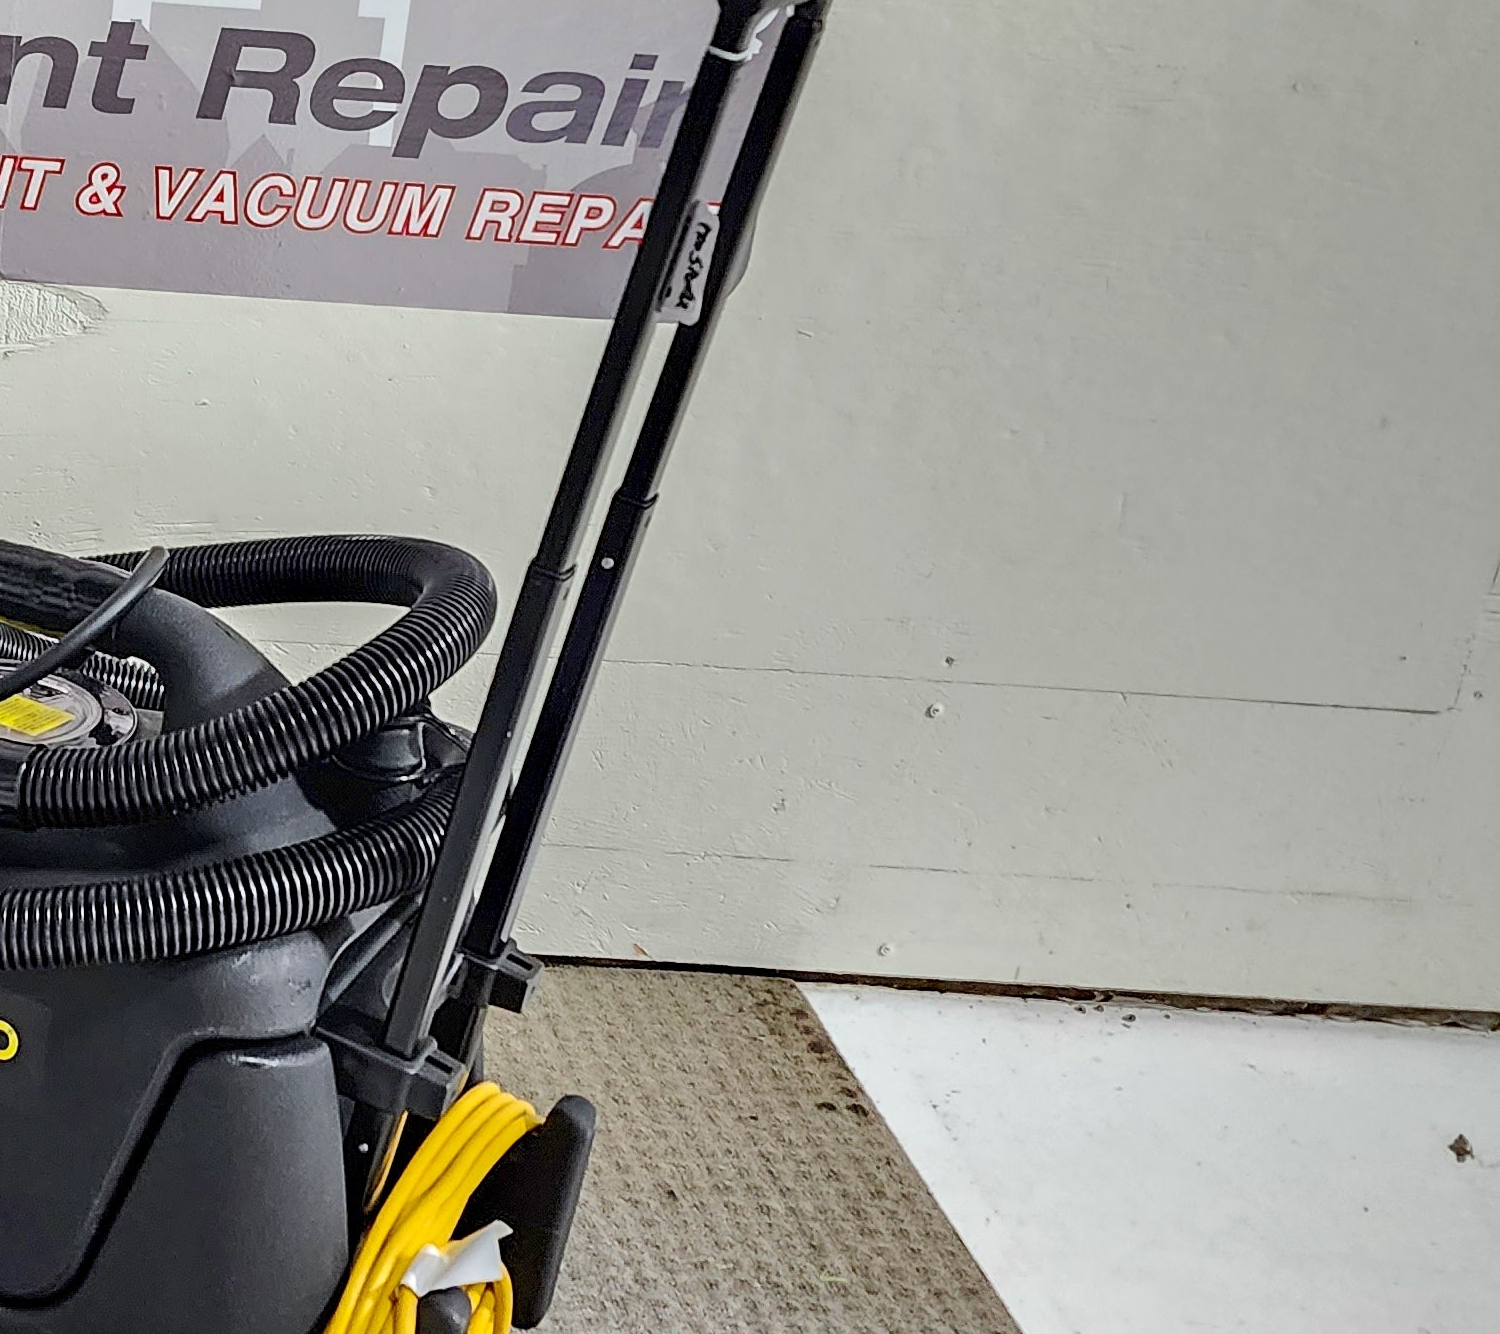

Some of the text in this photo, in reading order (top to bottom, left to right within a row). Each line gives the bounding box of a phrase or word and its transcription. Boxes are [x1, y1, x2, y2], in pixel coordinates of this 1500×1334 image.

[195, 27, 692, 159] Repair
[74, 163, 126, 218] &
[153, 165, 457, 240] VACUUM
[466, 187, 721, 250] REPA
